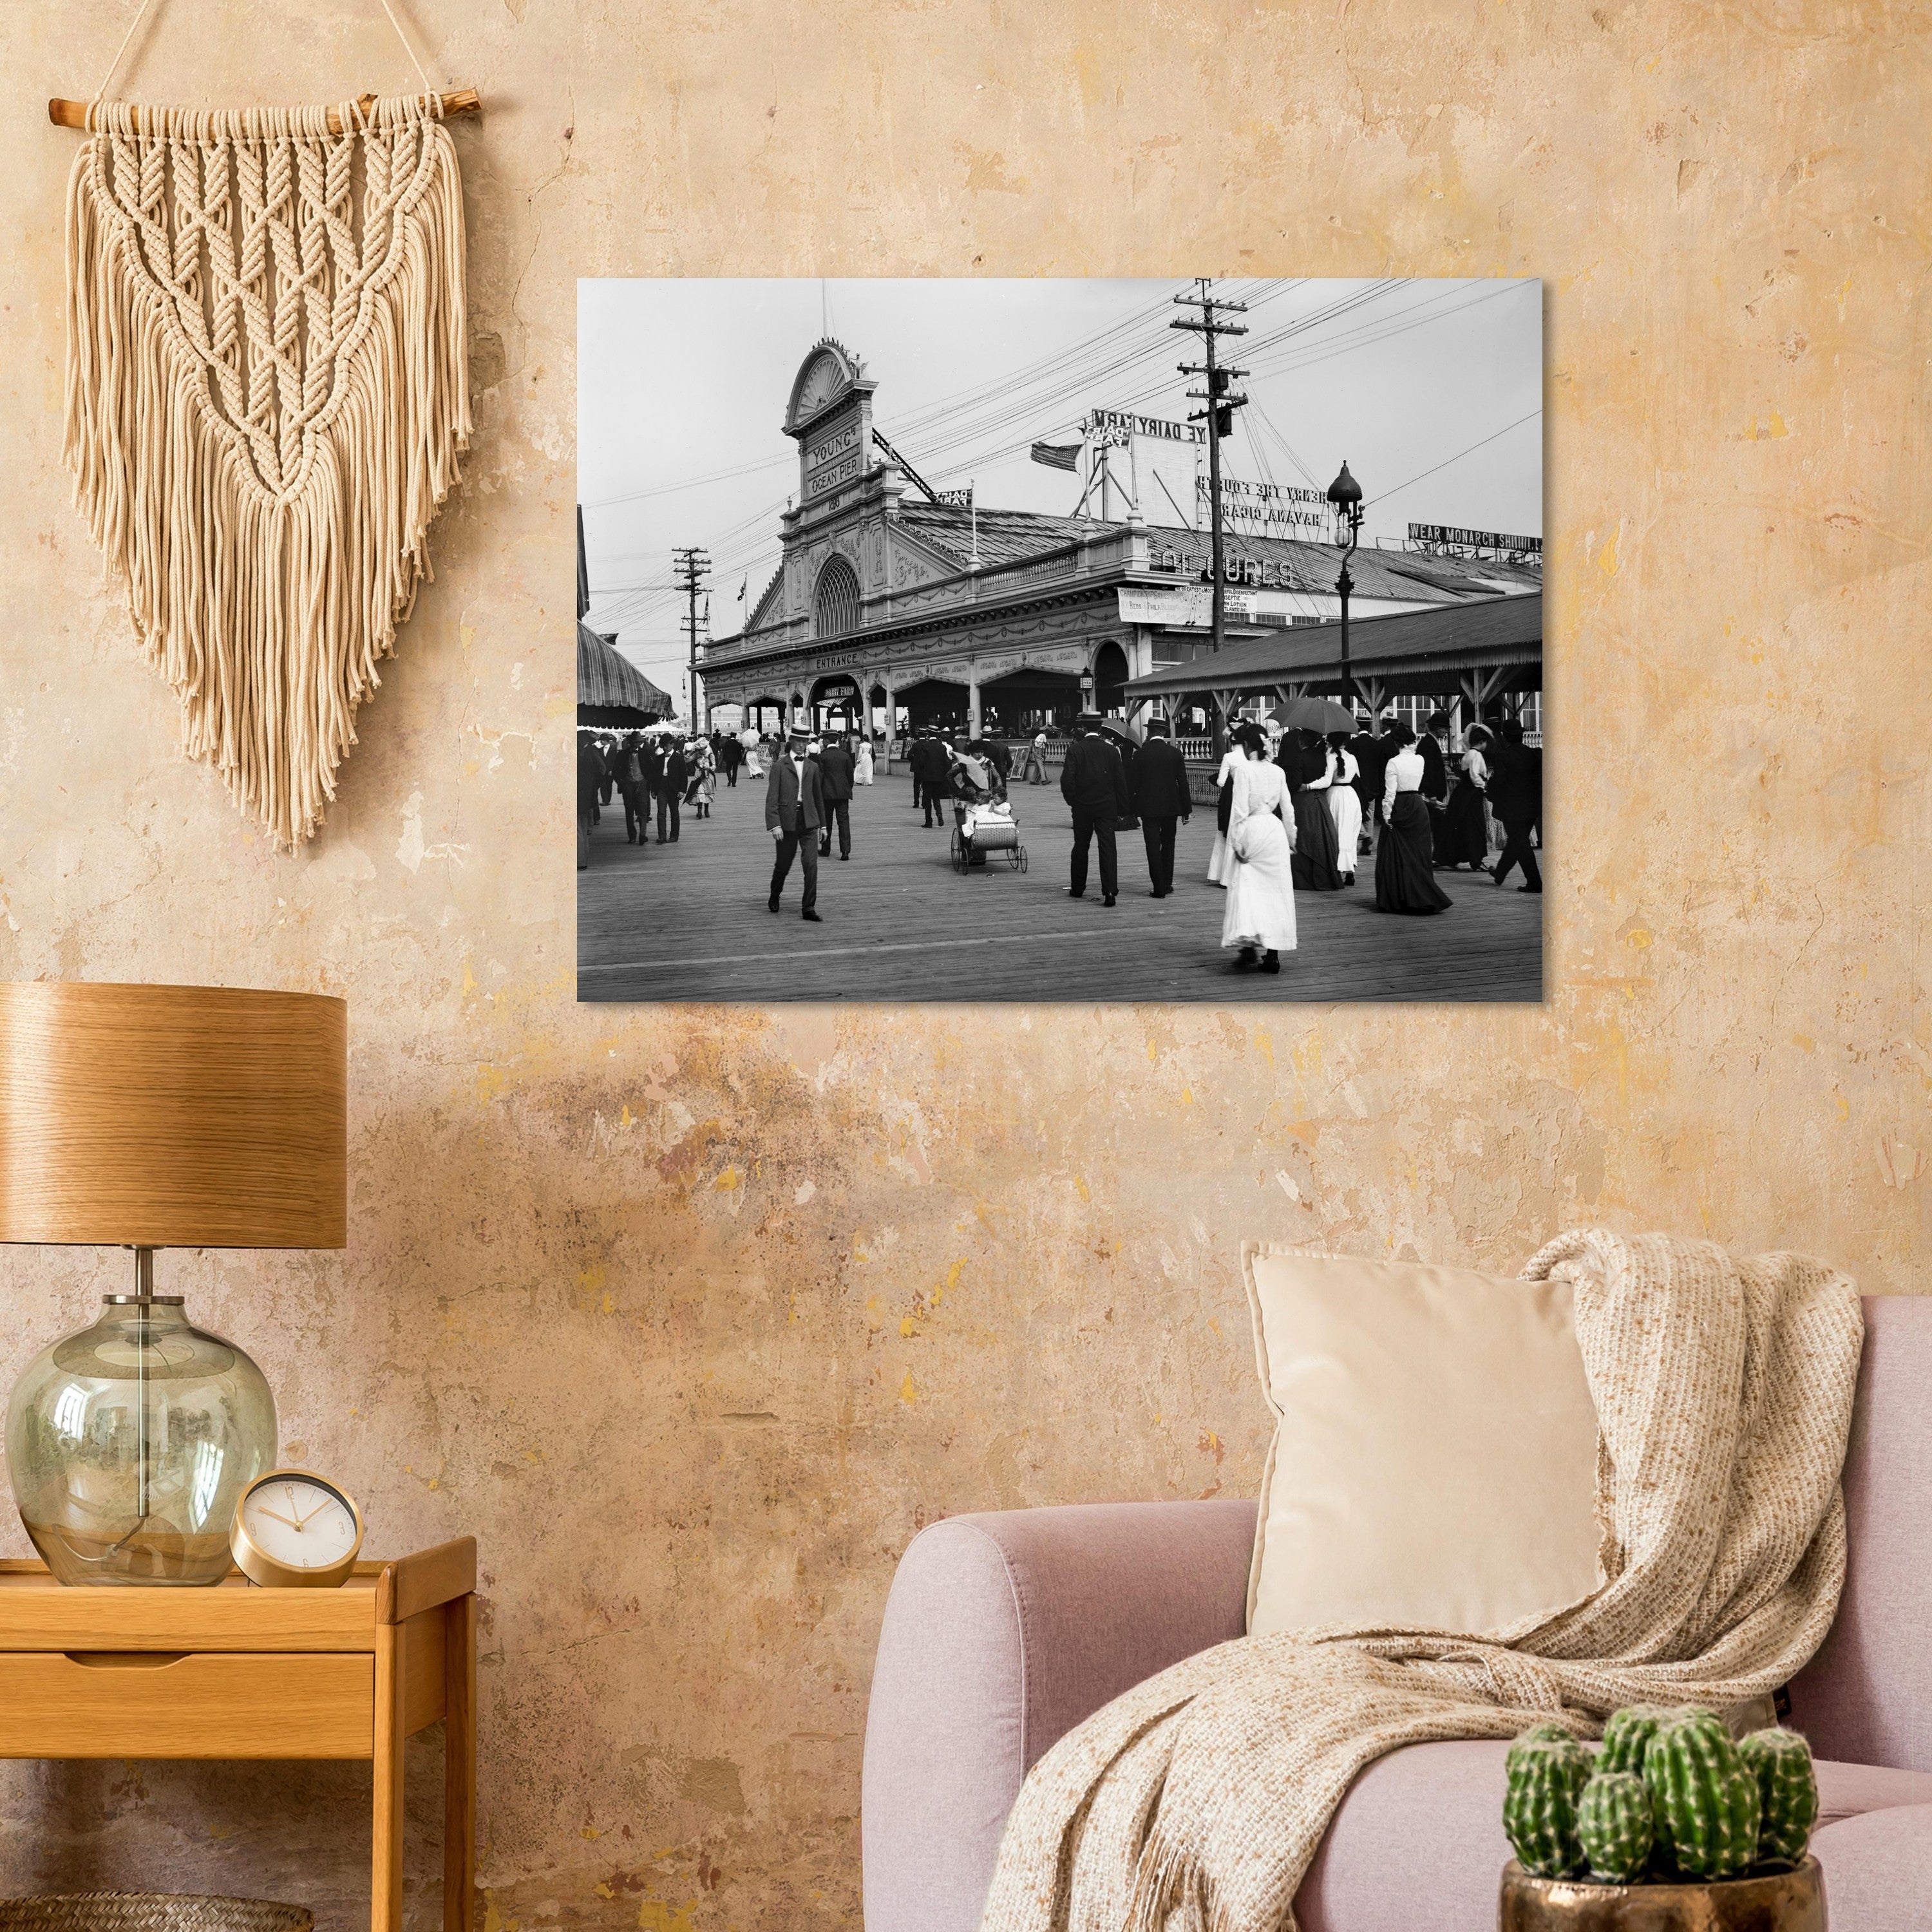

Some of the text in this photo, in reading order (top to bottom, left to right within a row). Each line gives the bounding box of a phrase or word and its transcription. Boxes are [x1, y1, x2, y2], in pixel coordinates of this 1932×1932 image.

[812, 459, 857, 493] OCEAN PIER
[1410, 523, 1441, 540] WEAR
[1445, 527, 1495, 547] MONARCH
[285, 1486, 295, 1500] 12
[249, 1522, 257, 1537] 9
[338, 1520, 346, 1535] 3
